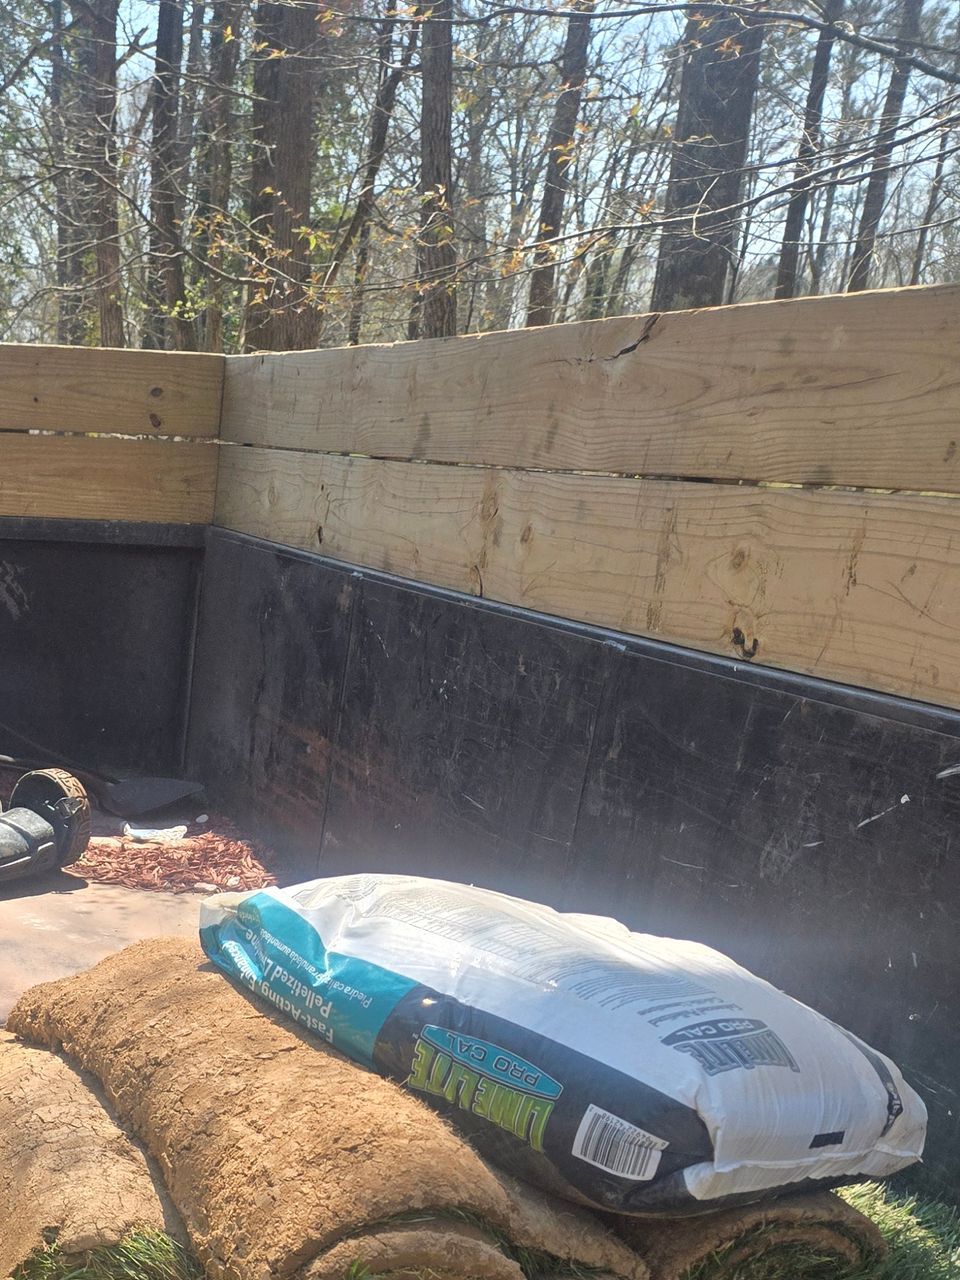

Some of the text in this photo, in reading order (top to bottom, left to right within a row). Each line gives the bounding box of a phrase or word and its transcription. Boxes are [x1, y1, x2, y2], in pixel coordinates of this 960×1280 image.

[221, 940, 334, 1042] Fast-Acting, Enhanced
[271, 965, 332, 1018] Pelletized
[344, 987, 372, 1008] Piedra
[675, 1025, 717, 1038] CAL
[446, 1032, 541, 1088] PRO CAL
